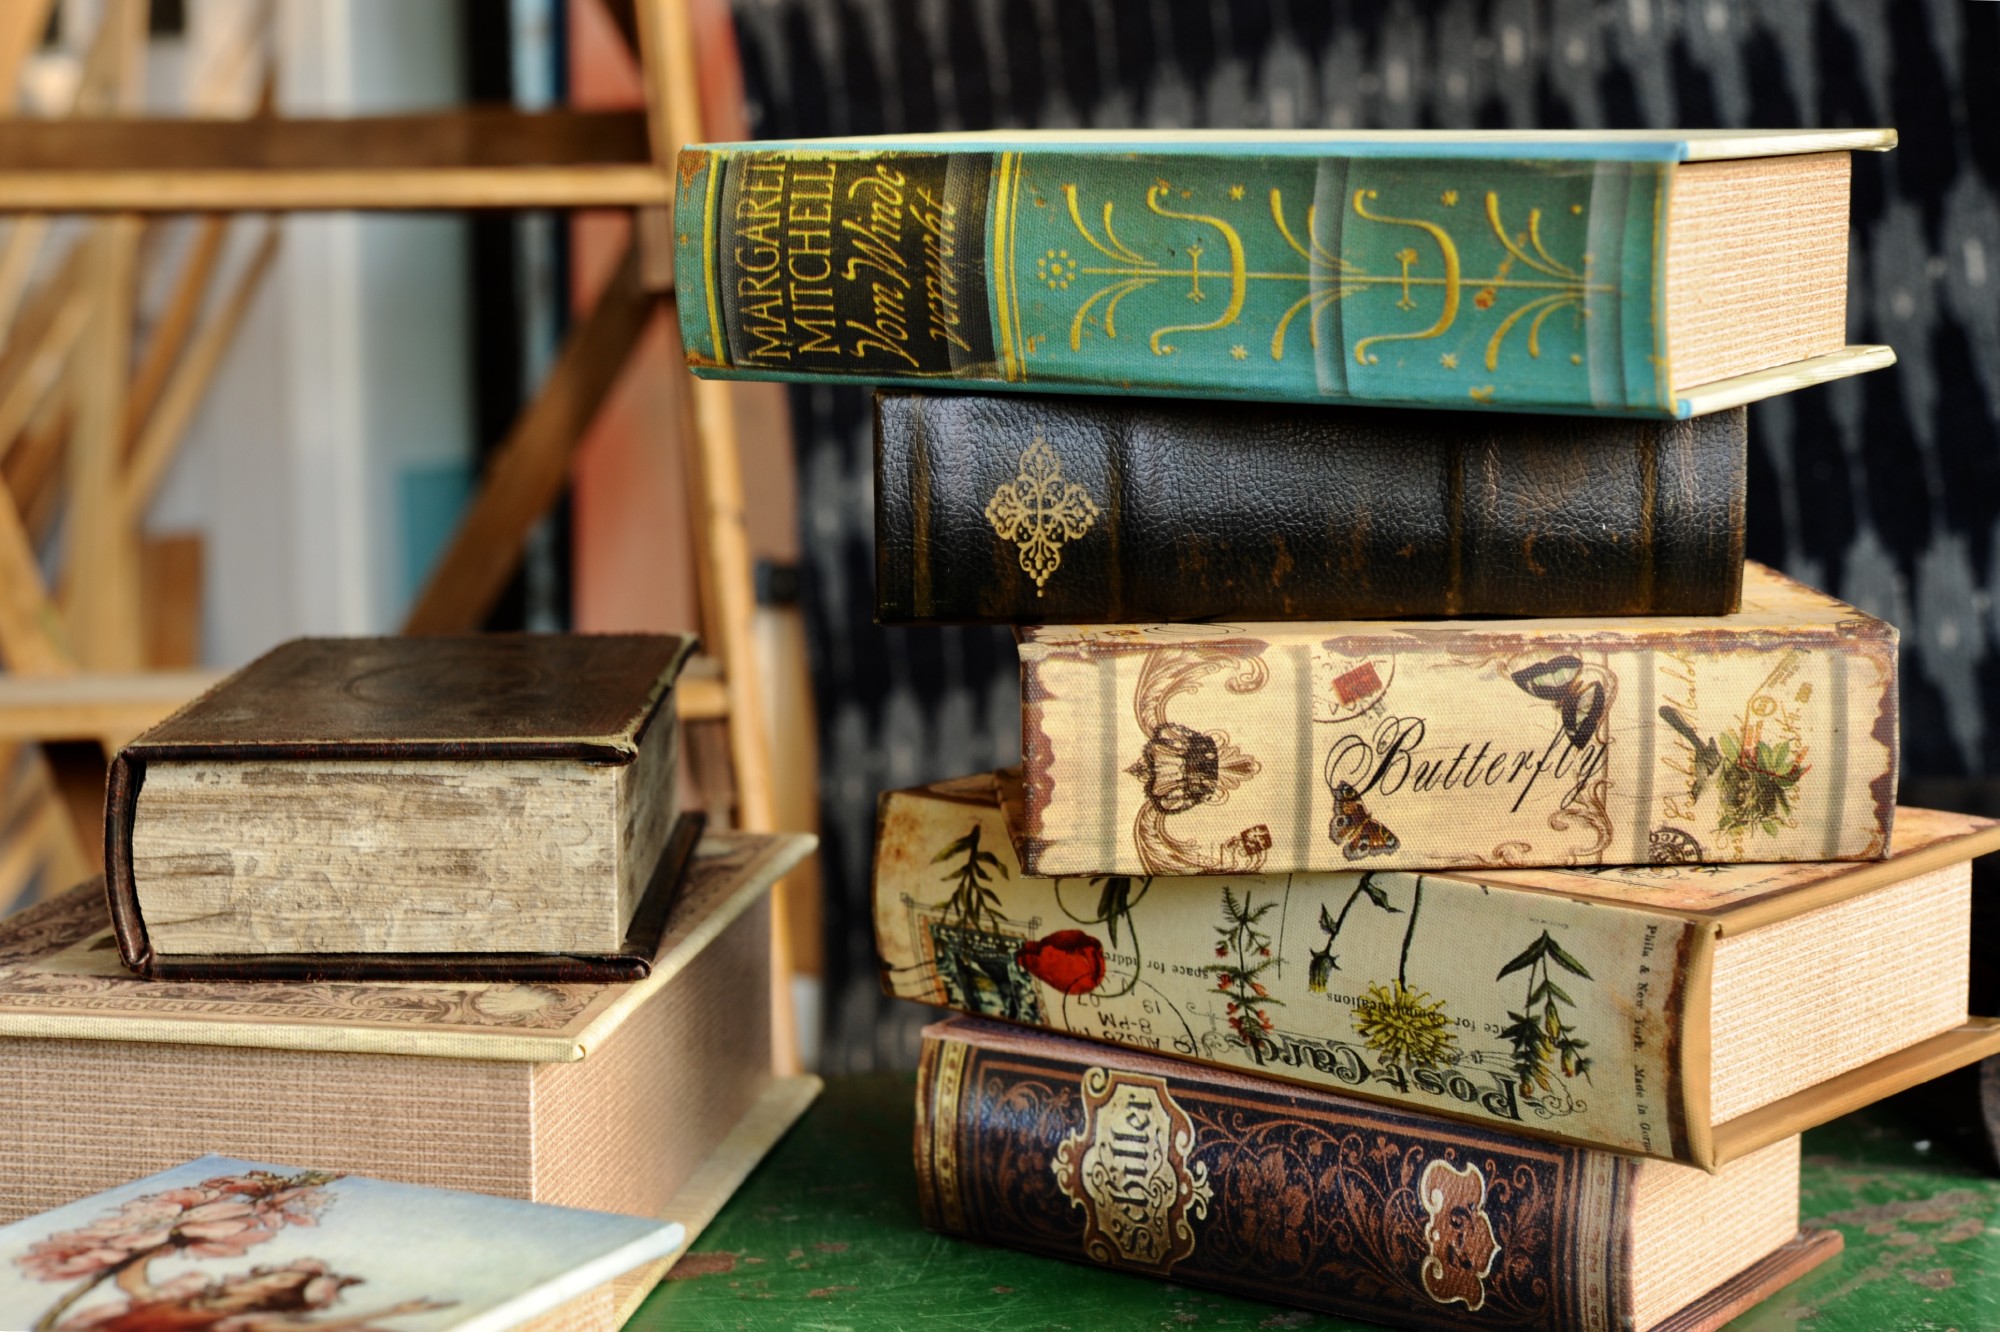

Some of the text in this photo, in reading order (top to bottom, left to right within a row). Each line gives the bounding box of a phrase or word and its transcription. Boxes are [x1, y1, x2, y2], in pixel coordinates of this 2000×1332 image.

[735, 158, 791, 361] MARGARET
[787, 162, 841, 355] MITCHELL
[841, 163, 920, 368] Vom Winde
[909, 187, 971, 352] verweht
[1325, 716, 1608, 812] Butterfly
[1147, 960, 1166, 975] for
[1172, 962, 1209, 979] space
[1639, 965, 1650, 975] &
[1142, 999, 1161, 1016] 19
[1637, 982, 1650, 1010] New
[1098, 1011, 1153, 1035] 8-PM
[1455, 1016, 1476, 1032] for
[1251, 1036, 1523, 1122] Post Card
[1634, 1065, 1645, 1099] Made
[1637, 1103, 1648, 1116] in
[1105, 1093, 1160, 1259] Schiller
